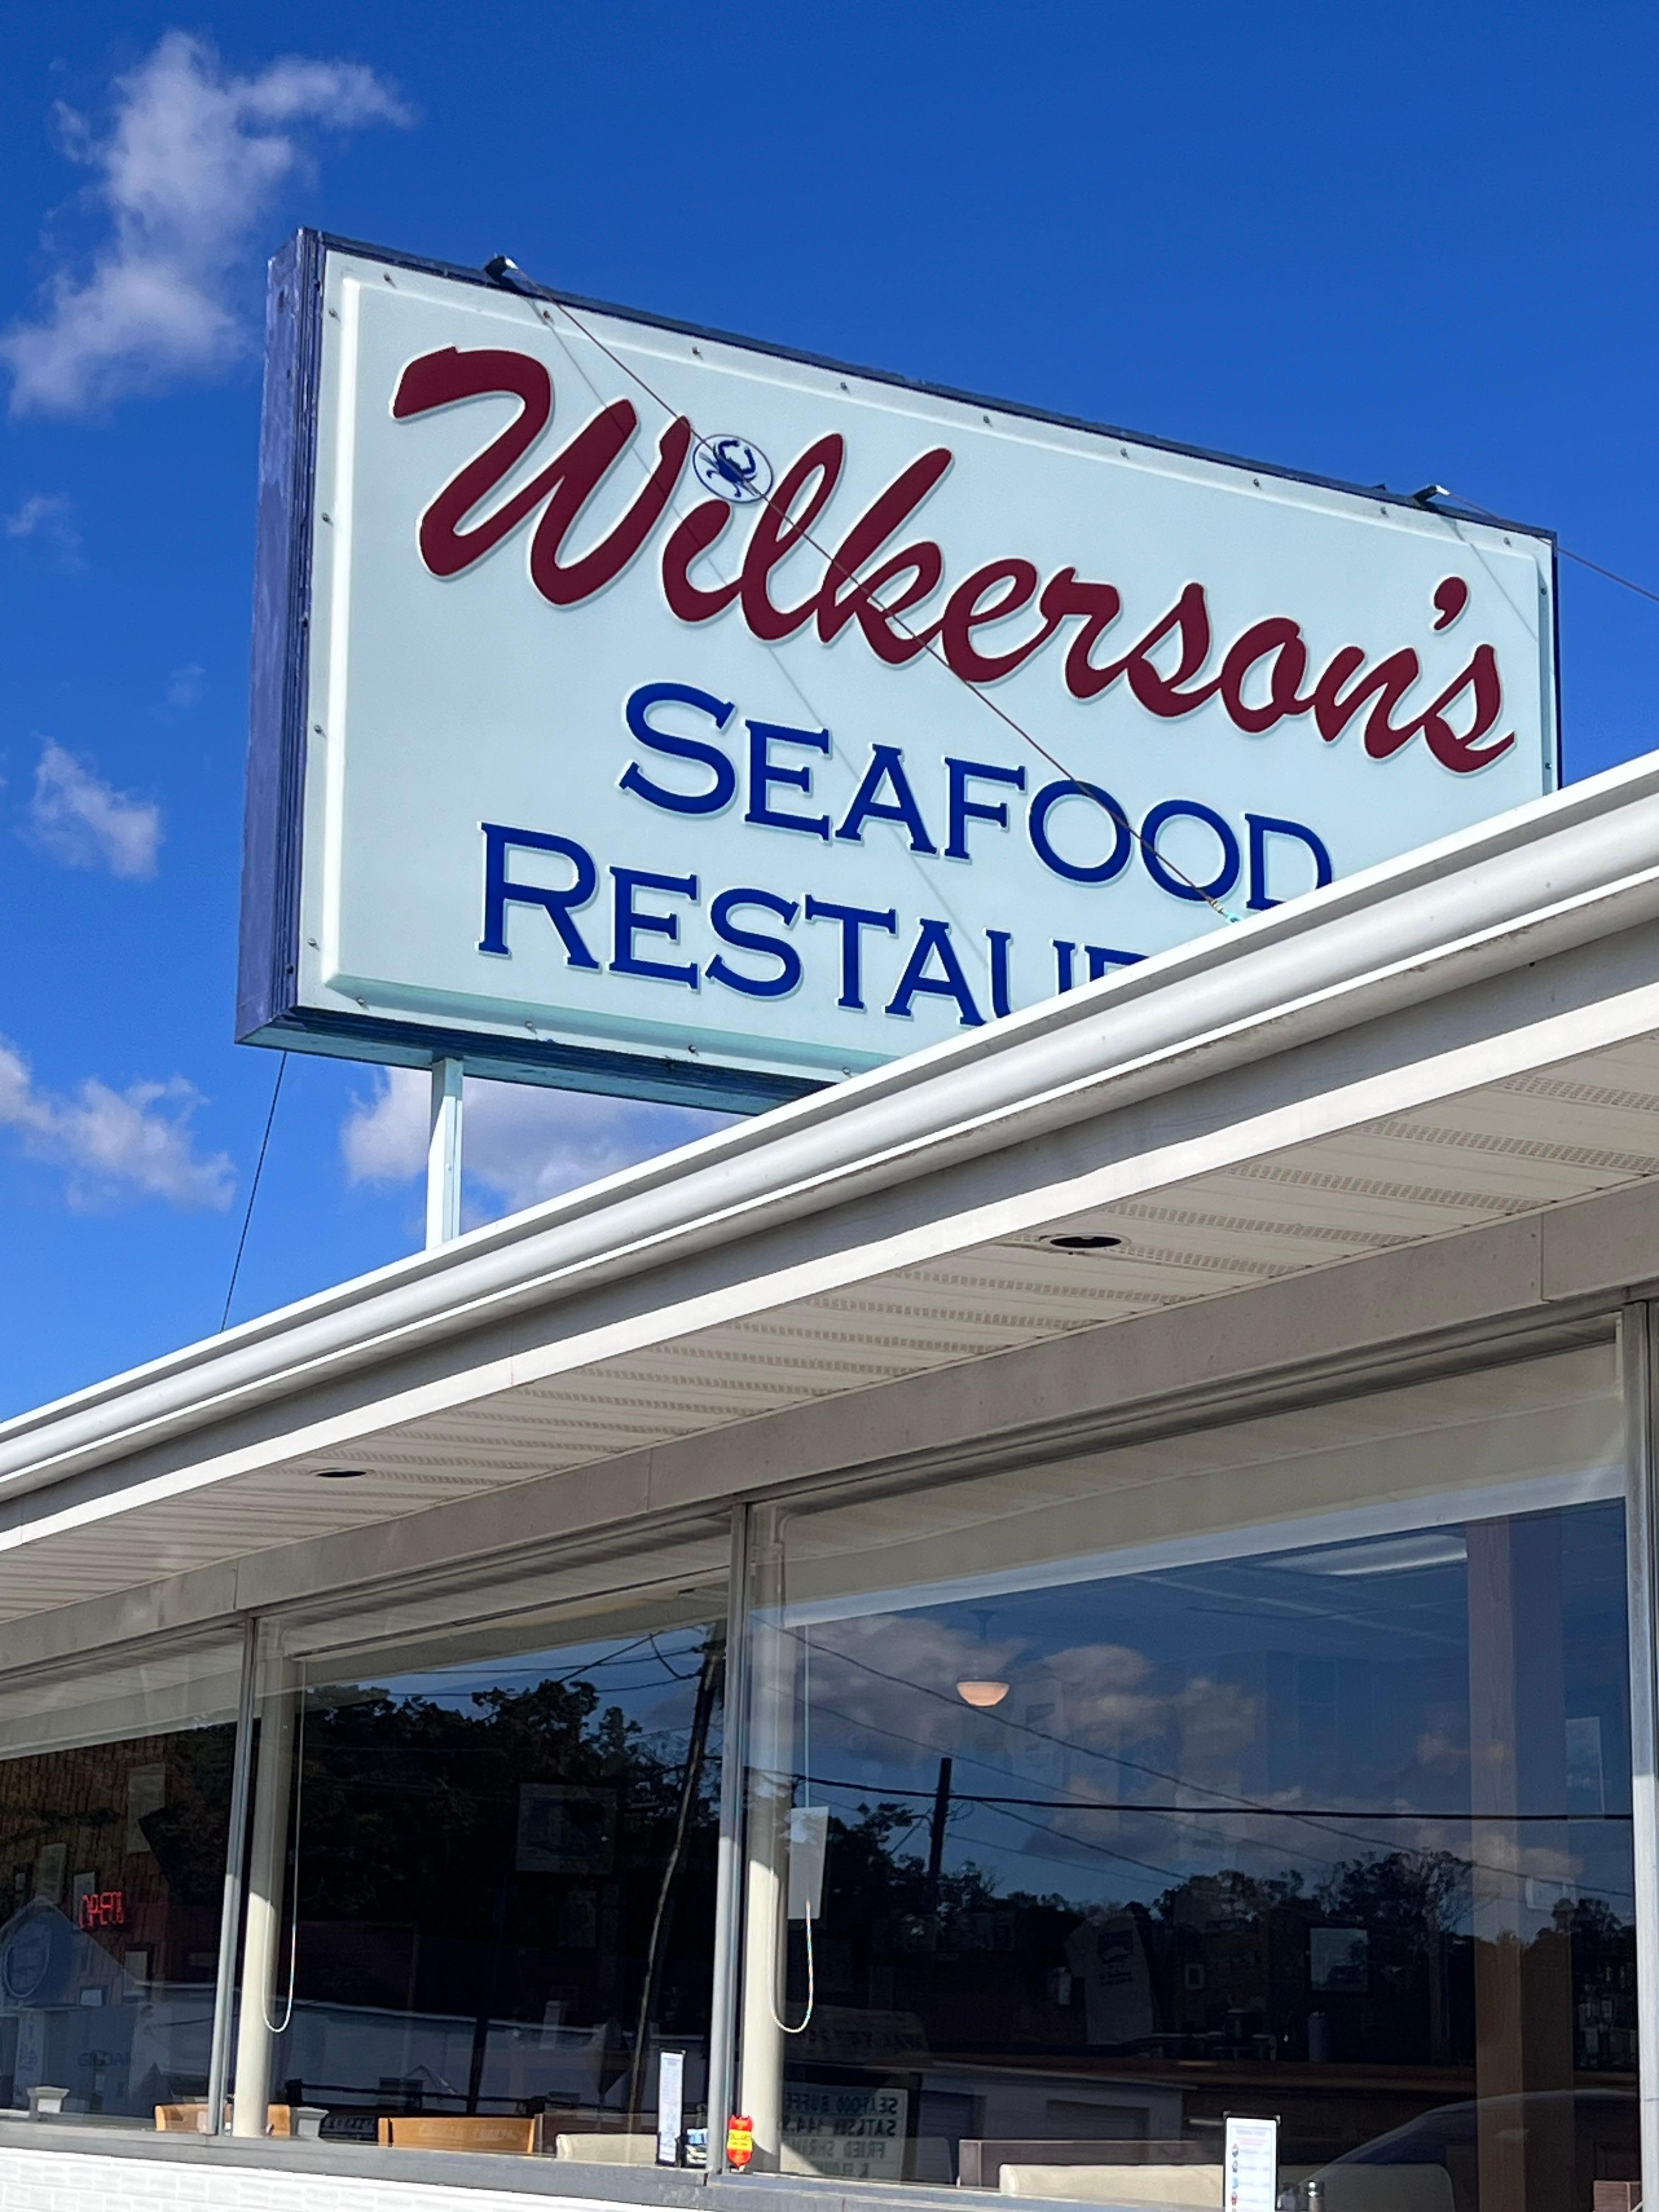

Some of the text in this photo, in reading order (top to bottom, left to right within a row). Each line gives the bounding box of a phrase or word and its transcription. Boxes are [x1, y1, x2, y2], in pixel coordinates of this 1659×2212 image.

[394, 348, 1514, 771] Wilkerson's
[620, 684, 1331, 910] SEAFOOD
[480, 823, 1147, 1026] RESTAU
